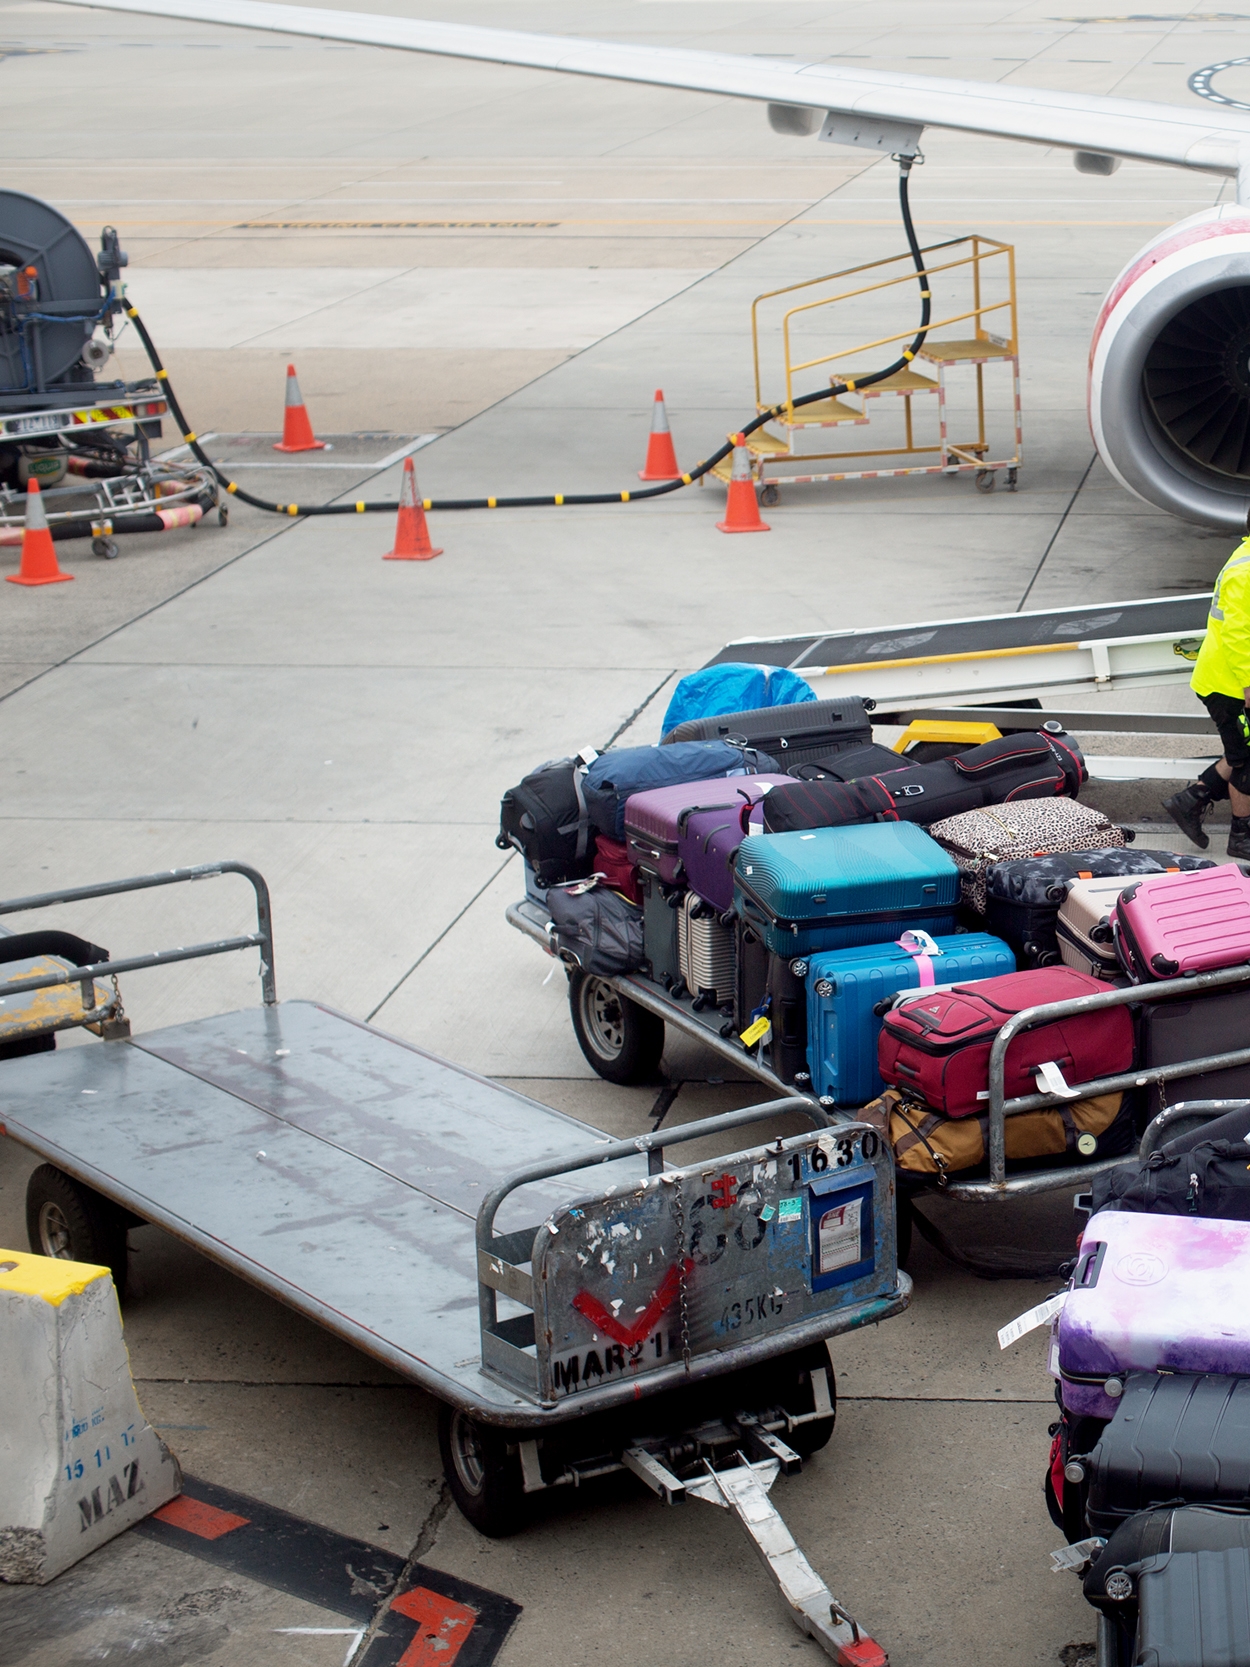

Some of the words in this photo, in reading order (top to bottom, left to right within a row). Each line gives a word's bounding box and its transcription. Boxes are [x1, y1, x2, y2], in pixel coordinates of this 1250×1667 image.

[787, 1131, 878, 1180] 1630
[554, 1344, 626, 1389] MAR
[64, 1458, 84, 1481] 15
[77, 1458, 146, 1534] MAZ
